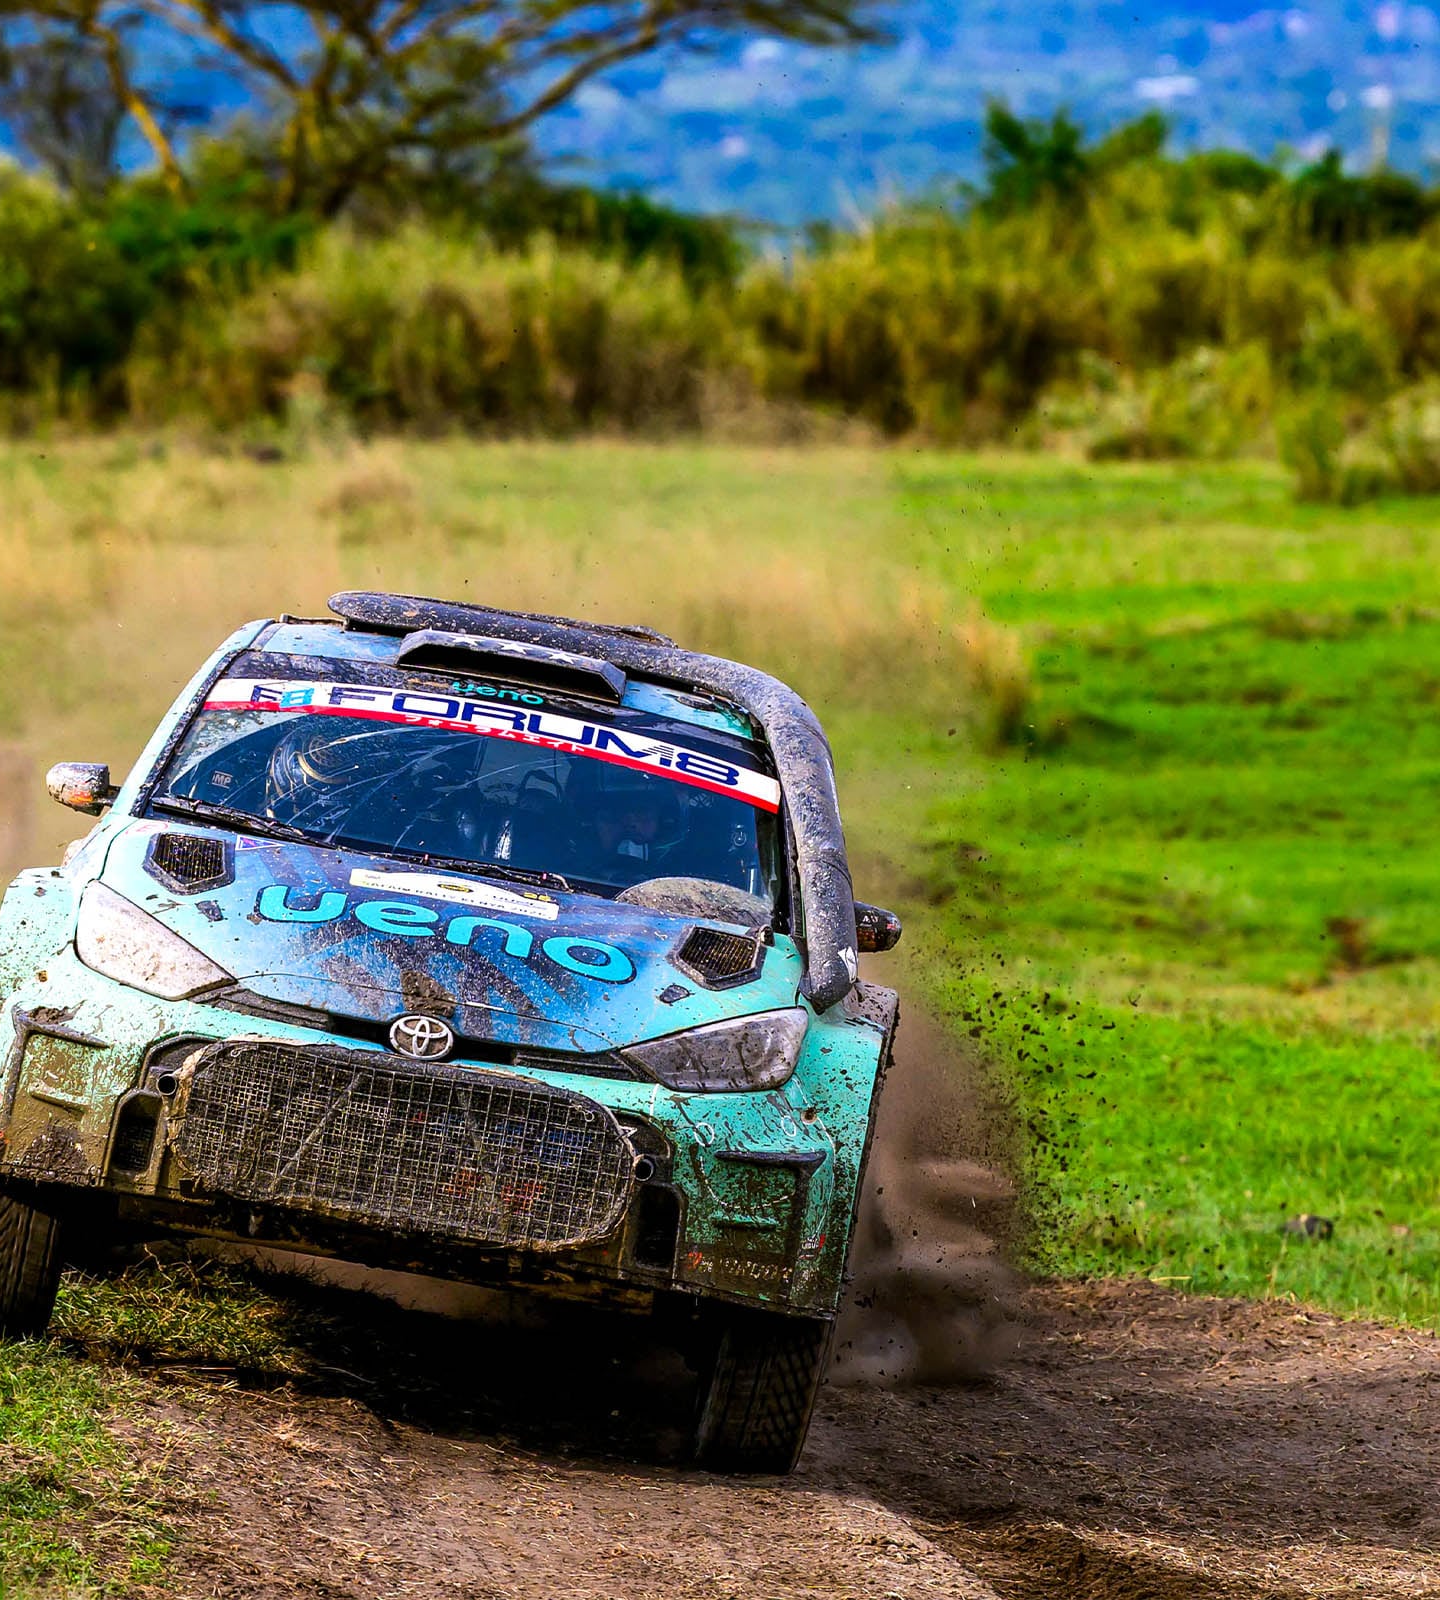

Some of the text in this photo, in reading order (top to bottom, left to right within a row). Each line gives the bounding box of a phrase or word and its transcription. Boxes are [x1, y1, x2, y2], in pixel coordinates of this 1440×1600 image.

[452, 680, 544, 705] ueno
[328, 686, 740, 786] FORUM8
[404, 715, 585, 752] フォーラムエイト
[258, 884, 637, 984] ueno
